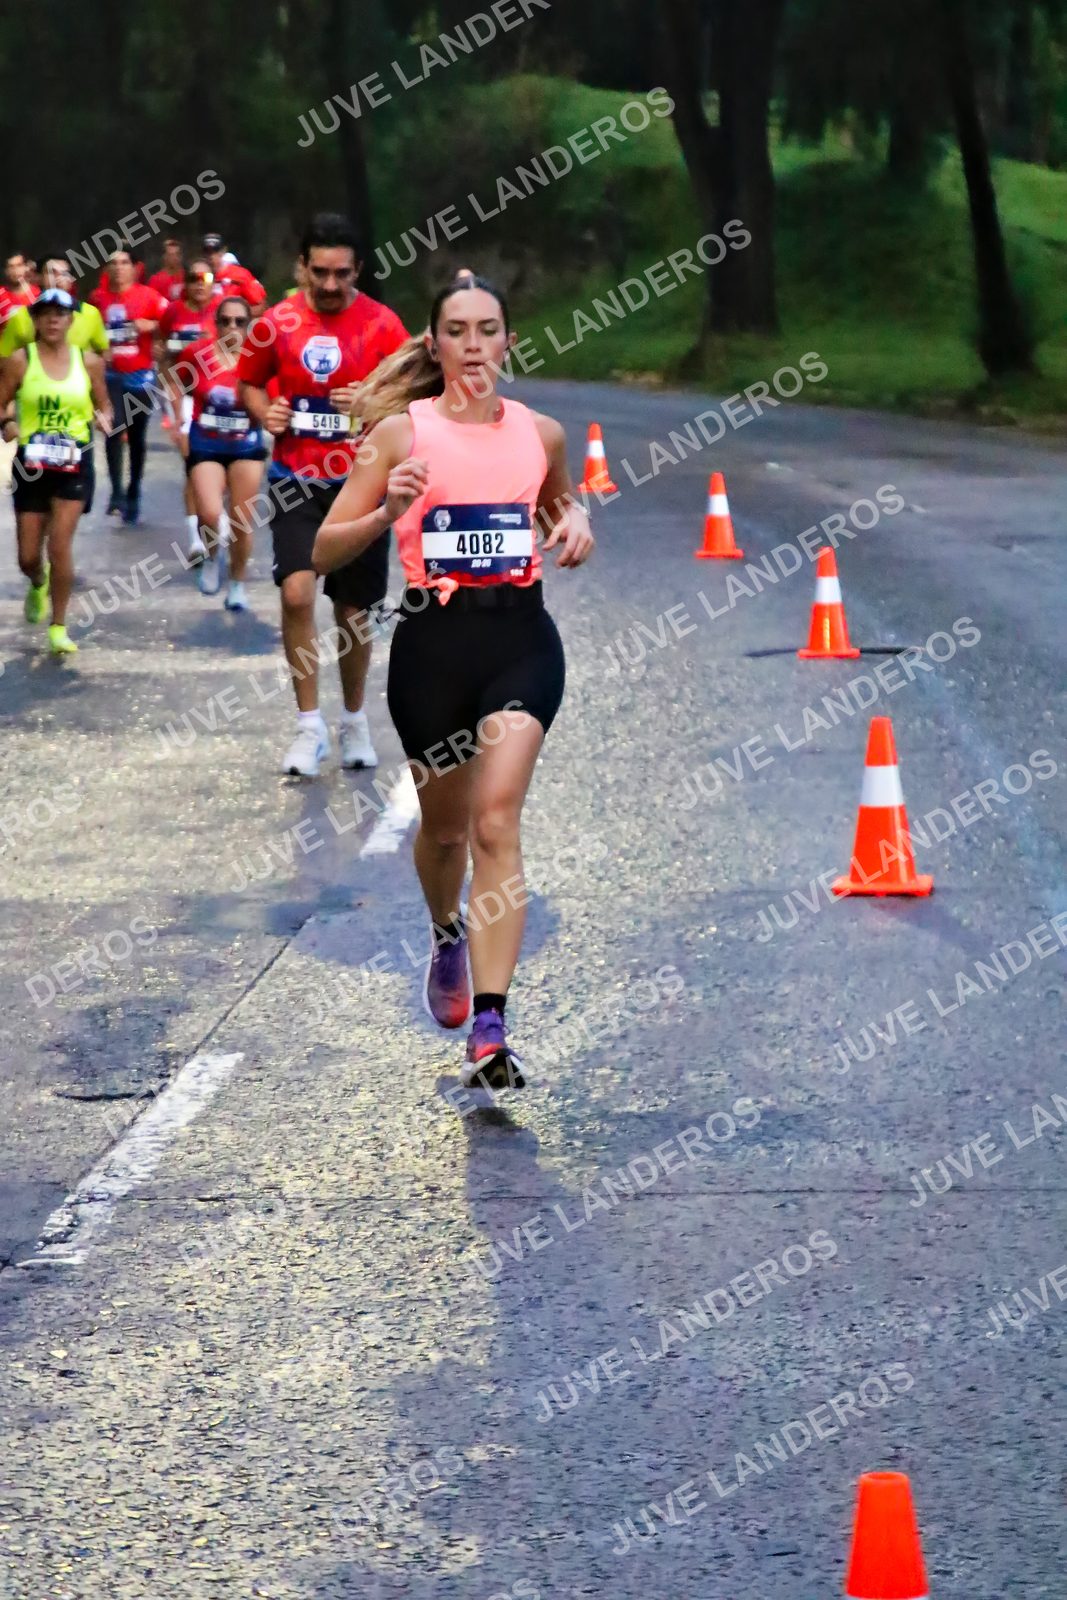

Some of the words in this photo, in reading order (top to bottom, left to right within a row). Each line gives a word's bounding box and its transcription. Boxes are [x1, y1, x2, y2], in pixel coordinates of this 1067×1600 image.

[38, 394, 60, 410] IN
[312, 414, 341, 429] 5419
[456, 532, 504, 554] 4082
